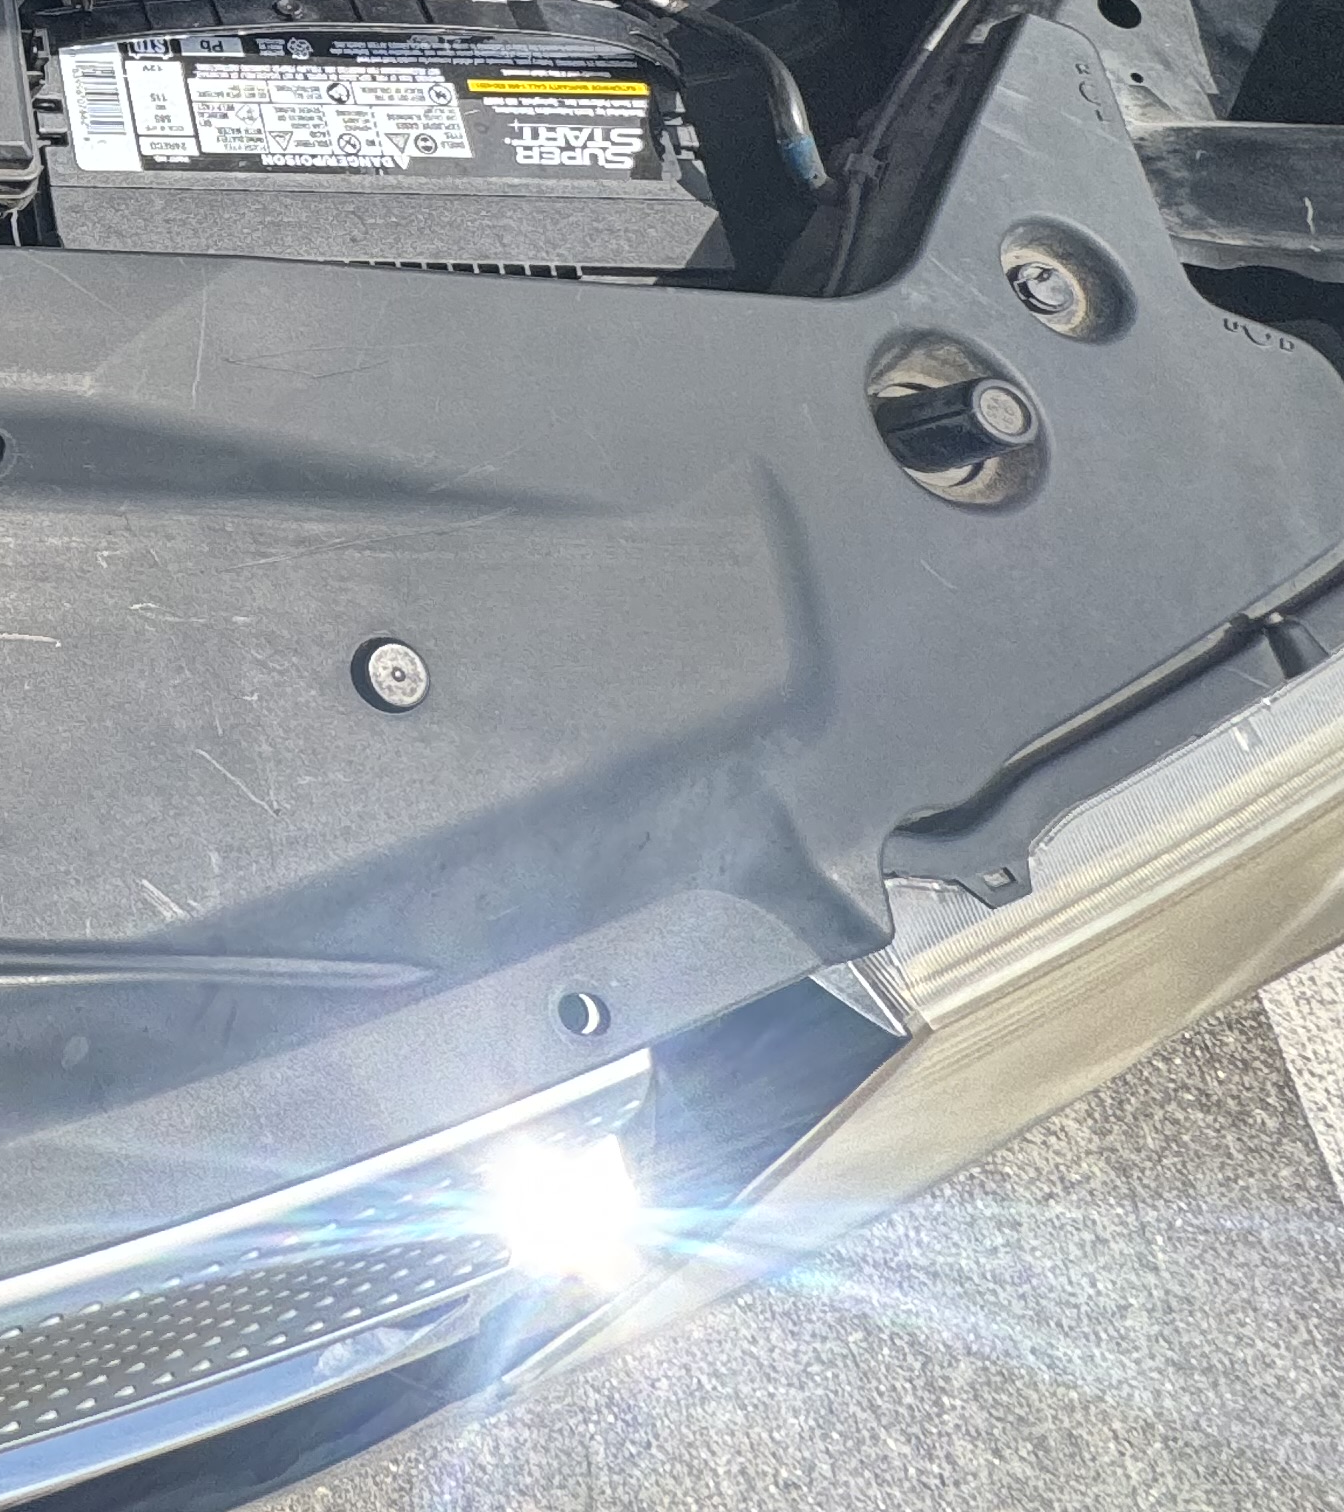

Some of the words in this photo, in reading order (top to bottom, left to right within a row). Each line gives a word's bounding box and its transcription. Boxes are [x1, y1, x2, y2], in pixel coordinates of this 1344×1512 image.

[199, 40, 223, 53] Pb
[142, 64, 163, 72] 12V
[149, 93, 168, 102] 115
[510, 127, 644, 153] START
[260, 153, 396, 169] DANGER/POISON
[515, 147, 635, 170] SUPER
